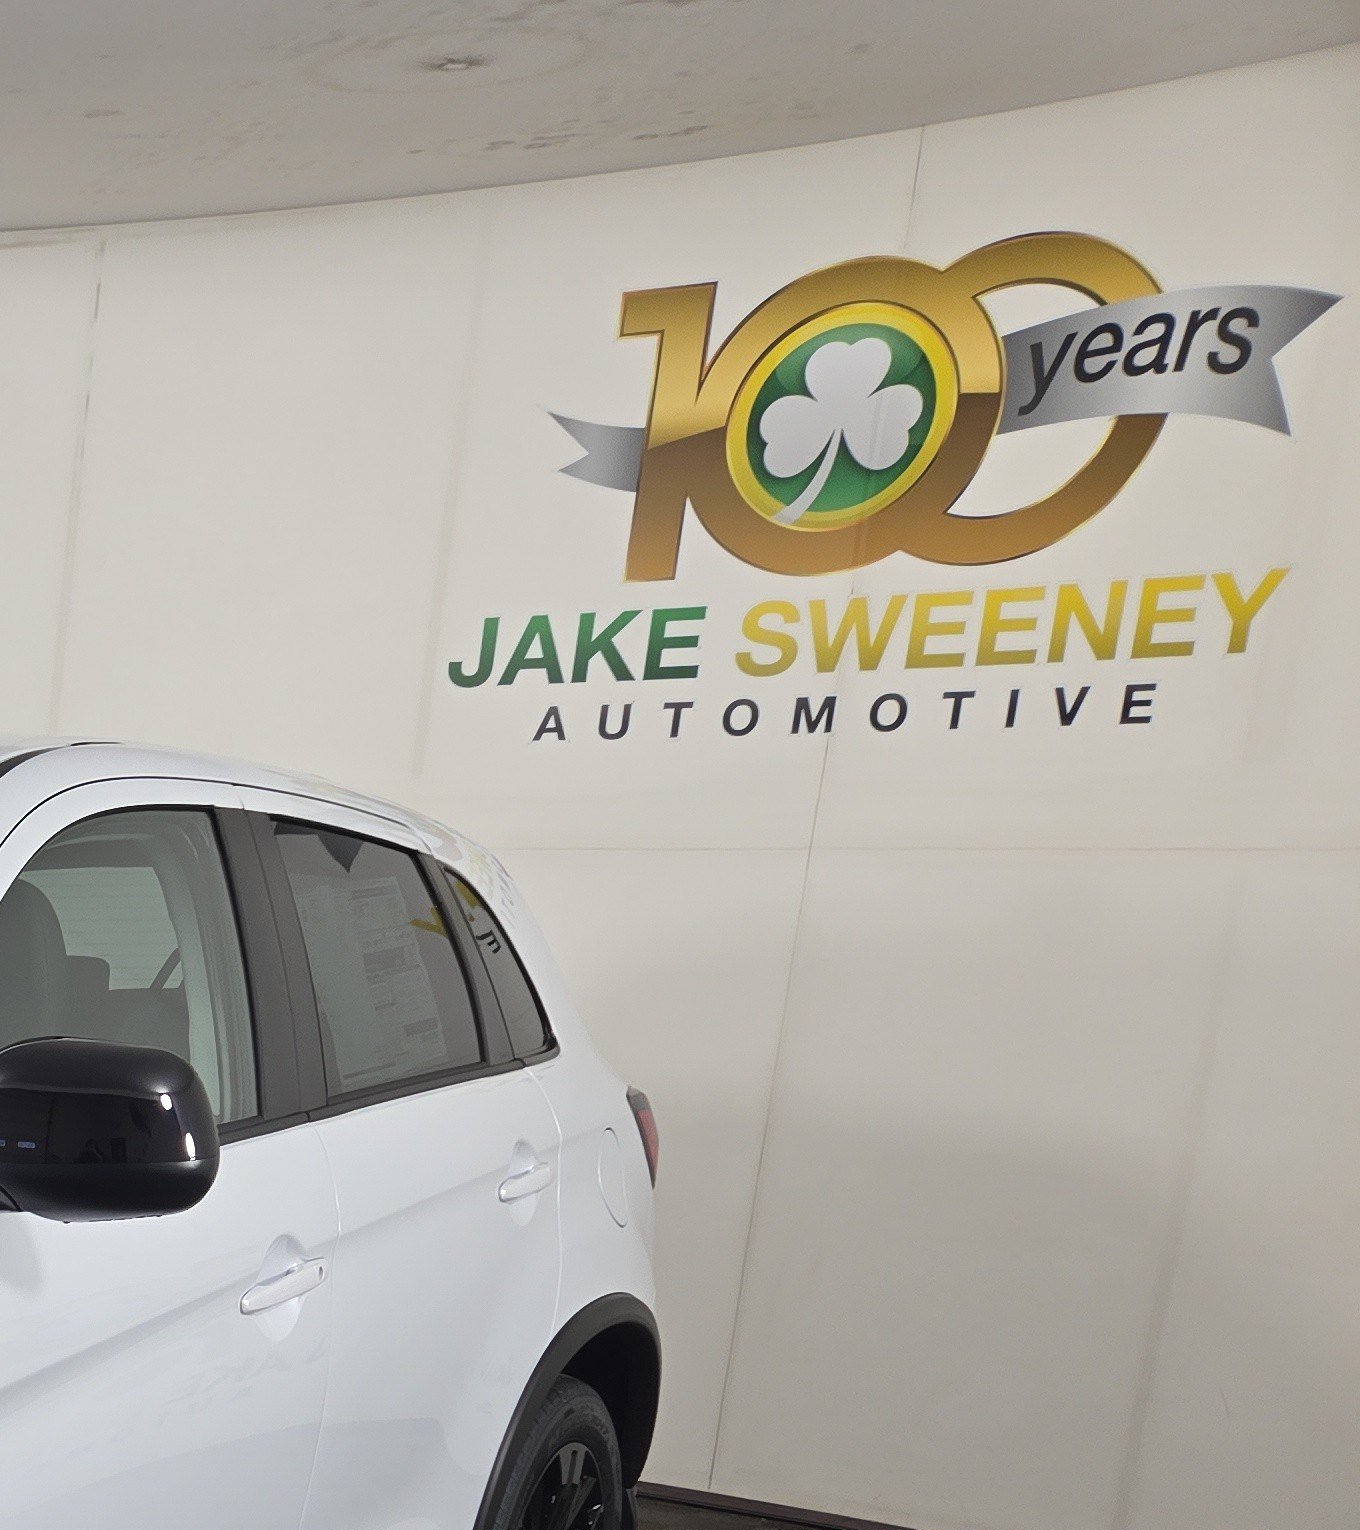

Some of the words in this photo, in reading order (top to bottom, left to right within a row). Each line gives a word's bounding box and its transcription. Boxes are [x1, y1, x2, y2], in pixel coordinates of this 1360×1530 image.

[618, 231, 1168, 583] 100
[1018, 305, 1259, 417] years
[448, 606, 707, 689] JAKE
[735, 567, 1290, 677] SWEENEY
[533, 684, 1157, 741] AUTOMOTIVE
